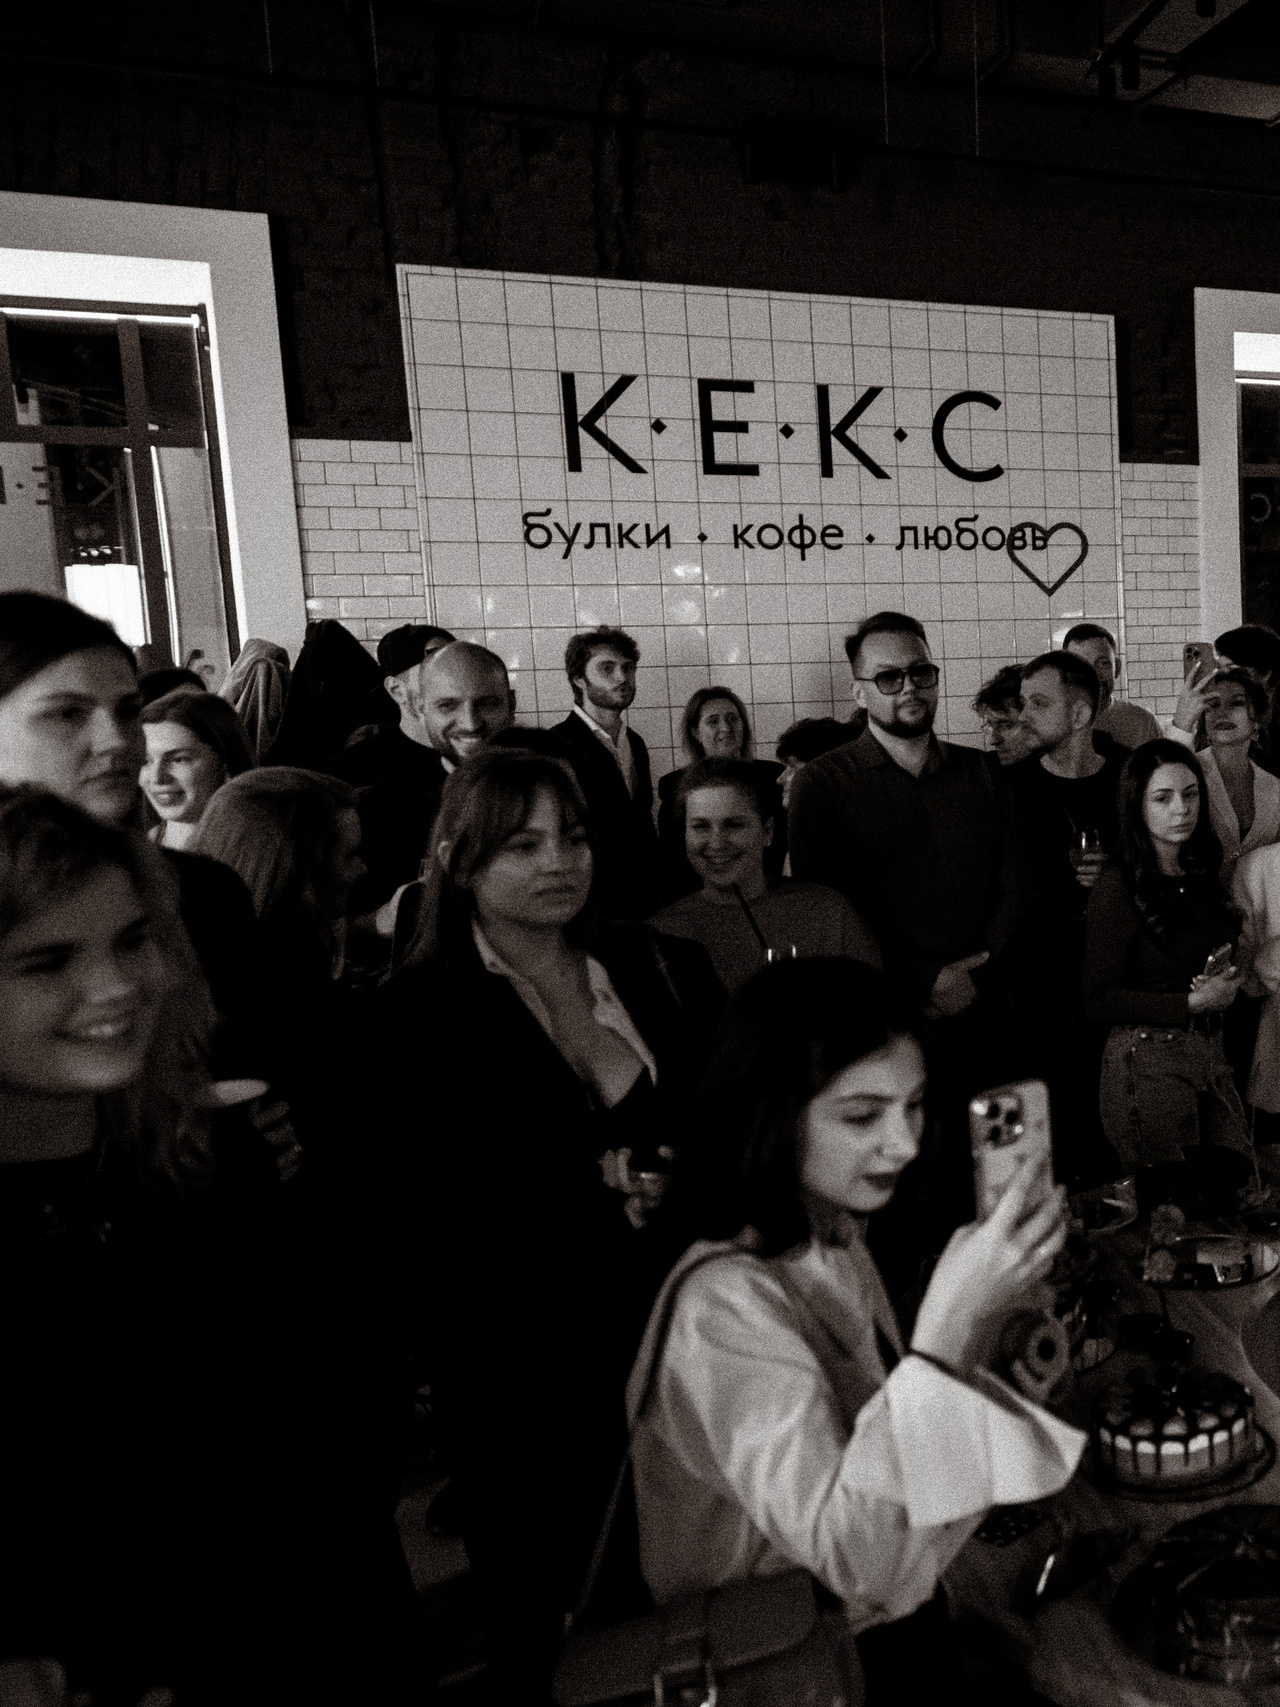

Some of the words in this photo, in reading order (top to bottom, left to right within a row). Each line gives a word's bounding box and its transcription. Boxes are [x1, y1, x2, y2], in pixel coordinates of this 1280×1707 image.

[521, 508, 672, 559] булки
[732, 514, 845, 560] кофе
[895, 514, 1048, 551] любовь
